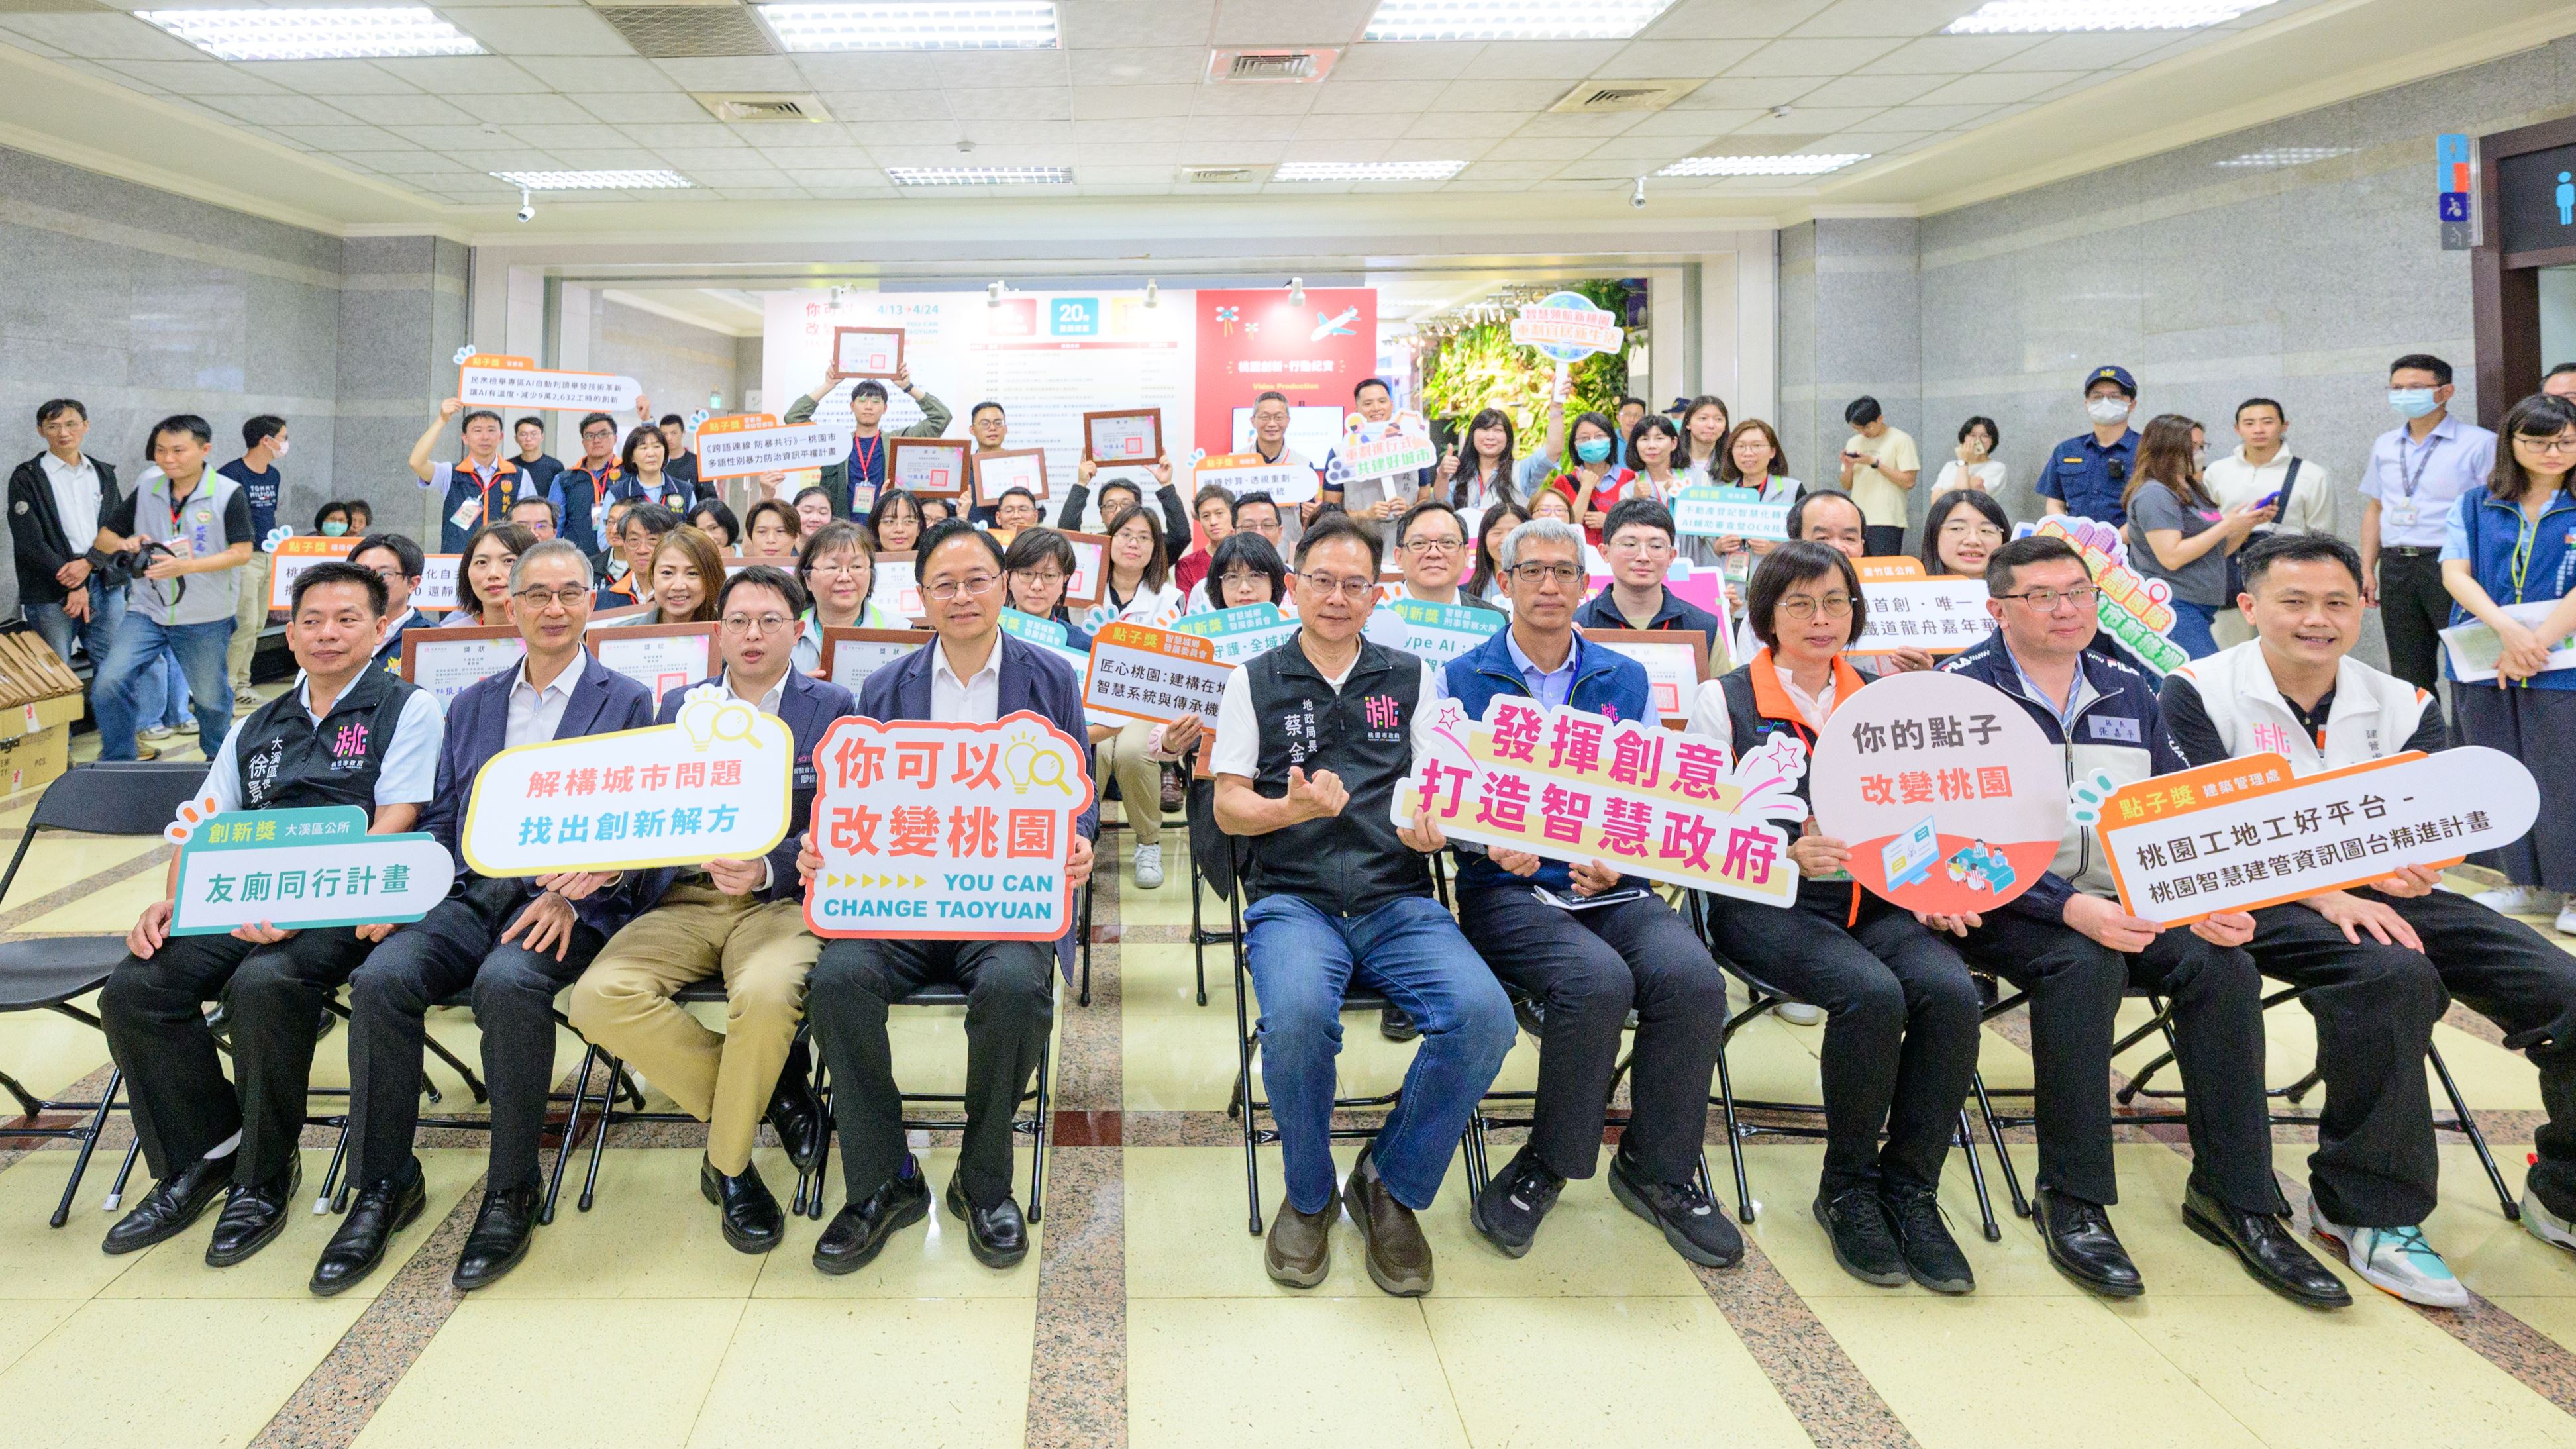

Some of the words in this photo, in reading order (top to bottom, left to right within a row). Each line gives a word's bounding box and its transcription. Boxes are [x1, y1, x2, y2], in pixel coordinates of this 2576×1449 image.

[877, 304, 903, 315] 4/13
[913, 304, 939, 315] 4/24
[1276, 382, 1319, 391] Production
[709, 419, 741, 432] 點子獎
[1206, 457, 1233, 468] 點子獎
[1357, 448, 1431, 475] 共建好城市
[289, 542, 326, 552] 點子獎
[1863, 566, 1916, 577] 蘆竹區公所
[1227, 608, 1262, 623] 智慧城鄉
[1229, 615, 1271, 632] 發展委員會
[1394, 603, 1440, 625] 創新獎
[1443, 619, 1498, 633] 刑事警察大隊
[1113, 626, 1159, 648] 點子獎
[1165, 634, 1201, 648] 智慧城鄉
[1164, 643, 1207, 660] 發展委員會
[2107, 658, 2141, 676] FILA
[1097, 679, 1219, 717] 智慧系統與傳承機
[1302, 699, 1318, 753] 地政局長
[1852, 714, 2002, 754] 你的點子
[262, 736, 283, 790] 大溪區長
[834, 737, 1002, 791] 你可以
[1492, 703, 1724, 802] 發揮創意
[525, 759, 742, 799] 解構城市問題
[1860, 766, 2014, 806] 改變桃園
[2118, 783, 2196, 821] 點子獎
[2202, 768, 2282, 799] 建築管理處
[208, 821, 276, 844] 創新獎
[285, 821, 350, 836] 大溪區公所
[518, 803, 739, 846] 找出創新解方
[830, 805, 1056, 860] 改變桃園
[1418, 758, 1780, 885] 打造智慧政府
[2136, 793, 2389, 872] 桃園工地工好平台
[2148, 809, 2494, 905] 桃園智慧建管資訊圖台精進計畫
[205, 864, 411, 904] 友廁同行計畫
[943, 874, 994, 891] YOU
[1003, 875, 1053, 893] CAN
[824, 899, 927, 917] CHANGE
[936, 901, 1052, 919] TAOYUAN
